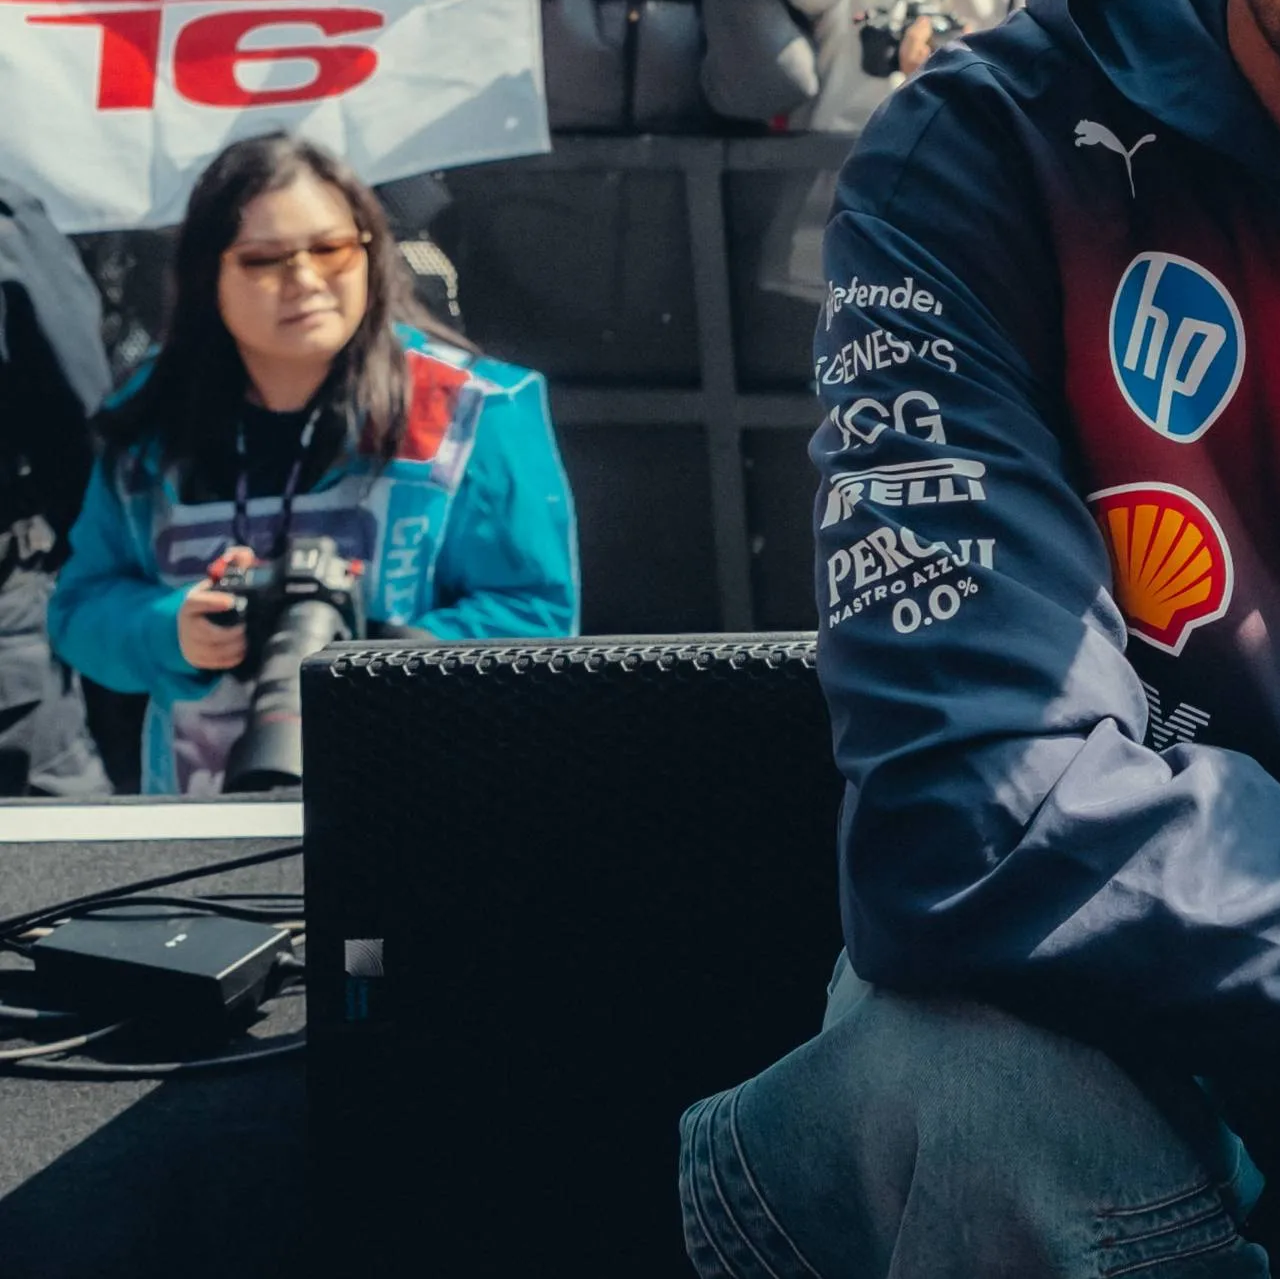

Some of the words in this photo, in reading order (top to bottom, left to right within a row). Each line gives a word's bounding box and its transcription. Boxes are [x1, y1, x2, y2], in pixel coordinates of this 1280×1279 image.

[24, 6, 385, 112] 16
[1123, 256, 1228, 432] hp
[819, 457, 987, 530] PRELLI
[828, 579, 907, 628] NASTRO
[891, 576, 979, 634] 0.0%
